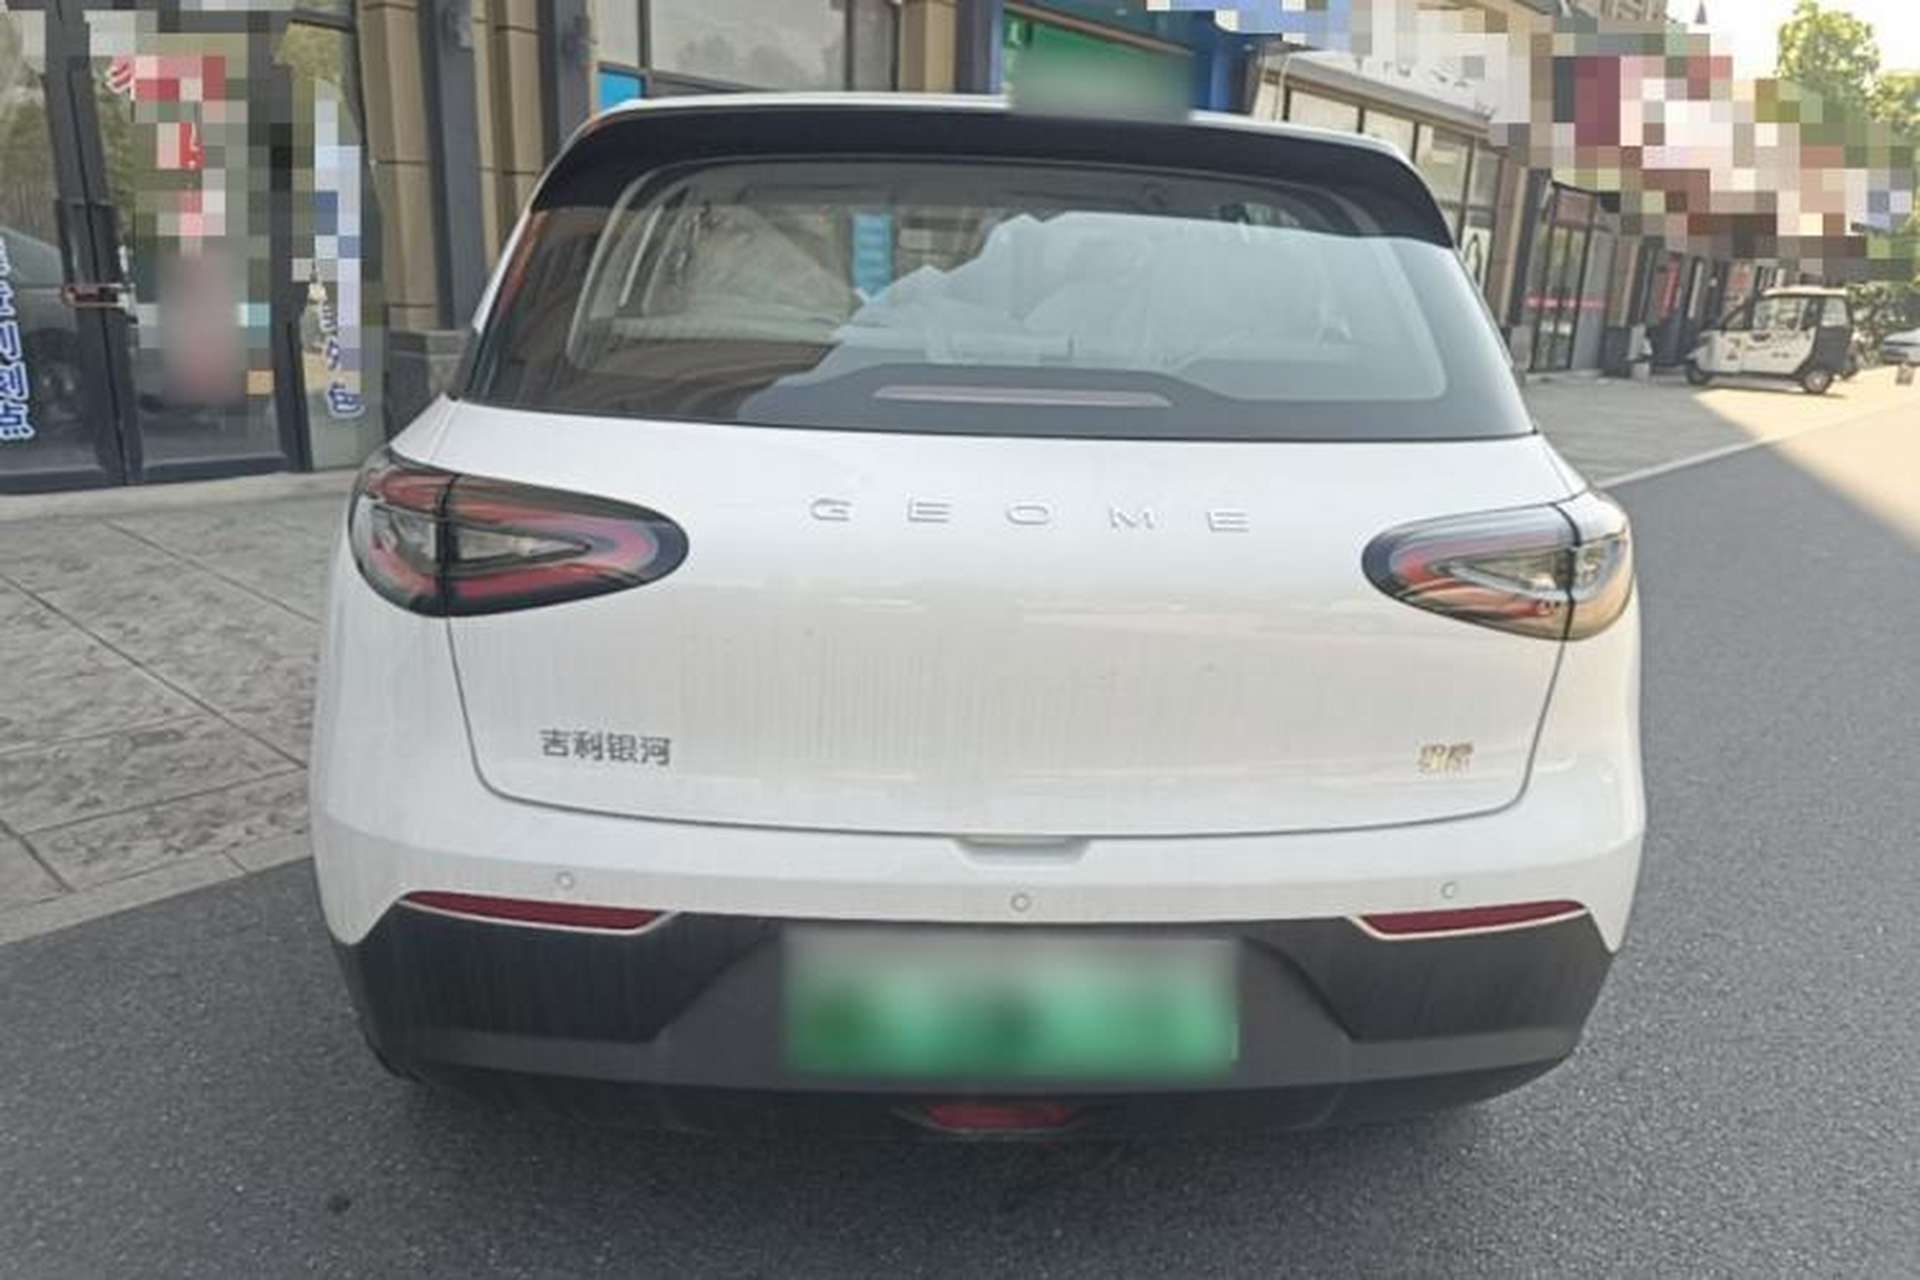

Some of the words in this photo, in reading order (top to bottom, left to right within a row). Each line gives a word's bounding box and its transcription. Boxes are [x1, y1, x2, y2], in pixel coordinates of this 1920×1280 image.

[809, 497, 1250, 533] GEOME
[539, 728, 672, 766] 吉利银河
